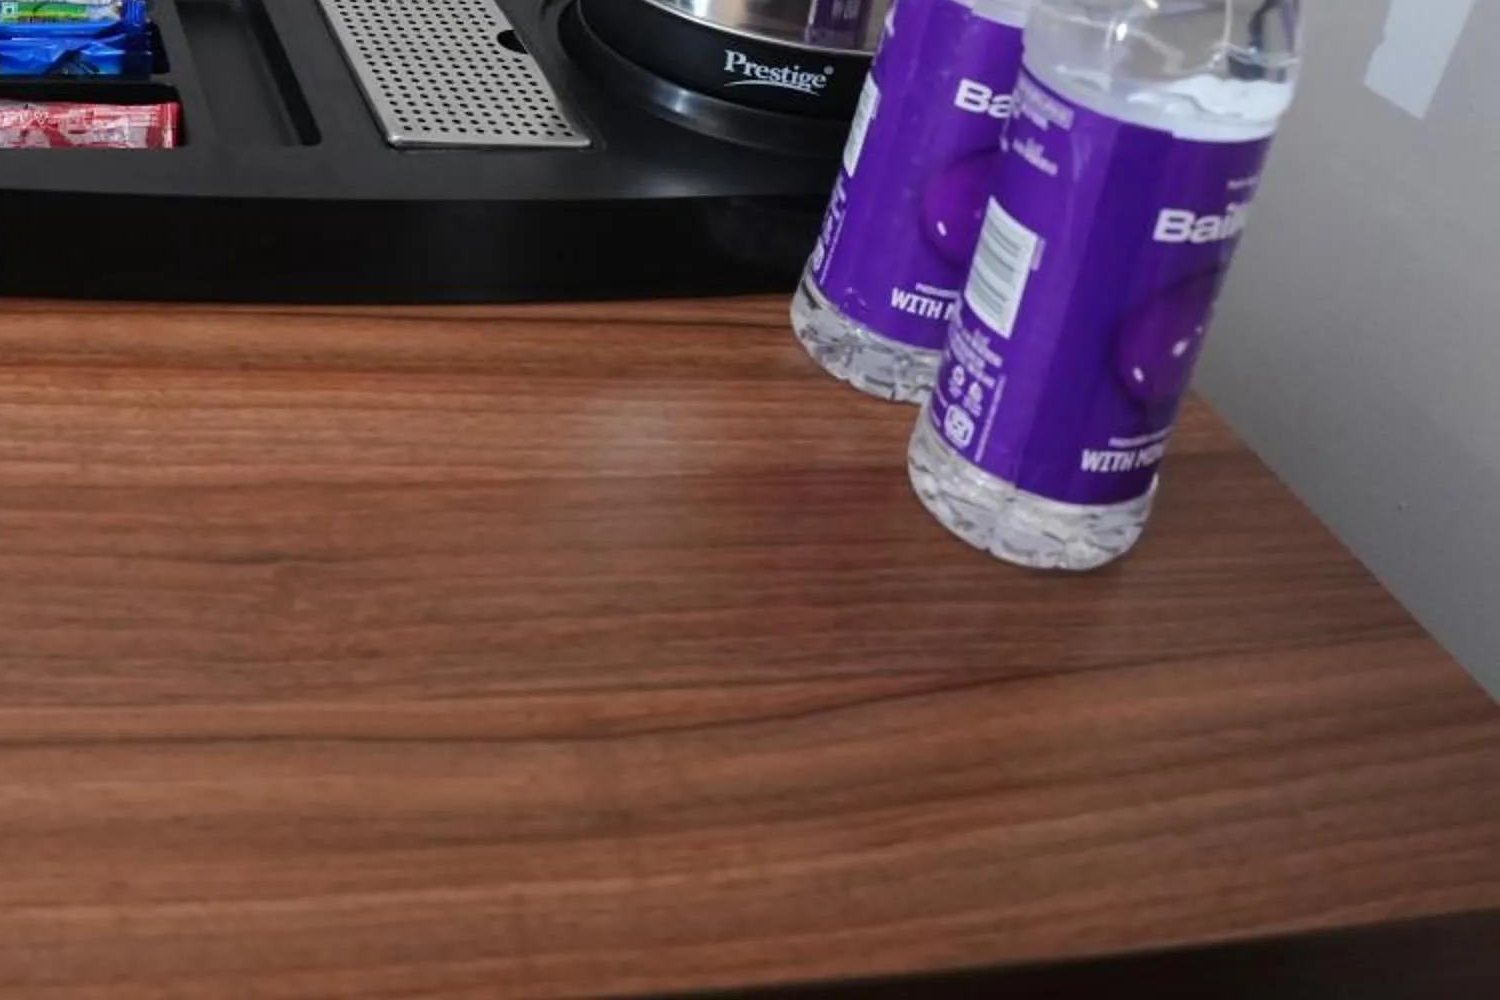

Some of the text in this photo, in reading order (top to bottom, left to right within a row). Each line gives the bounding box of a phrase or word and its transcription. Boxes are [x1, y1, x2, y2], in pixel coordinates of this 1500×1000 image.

[723, 49, 828, 91] Prestige
[891, 287, 944, 320] WITH
[1080, 448, 1137, 473] WITH
